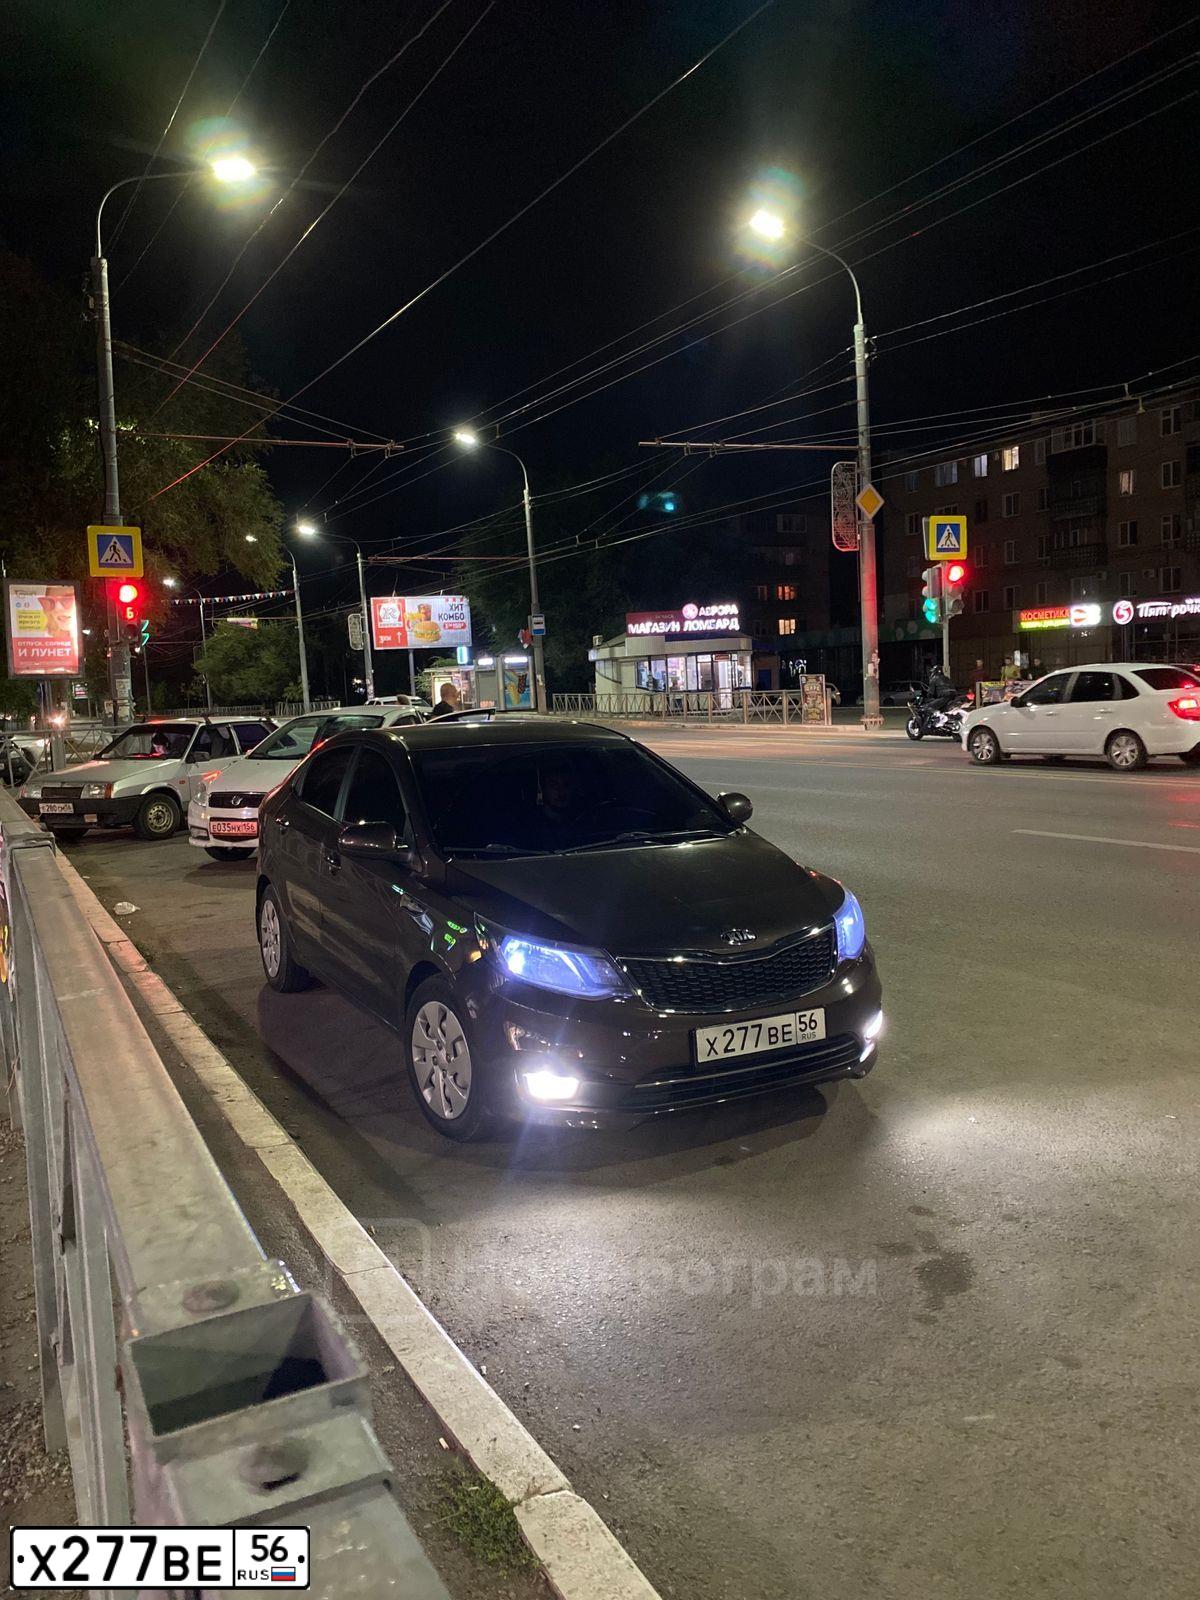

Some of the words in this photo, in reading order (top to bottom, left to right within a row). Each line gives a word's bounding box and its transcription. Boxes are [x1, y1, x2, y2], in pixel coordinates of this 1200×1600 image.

[438, 613, 465, 621] КОМБО
[628, 621, 680, 634] МАГАЗИН
[683, 618, 740, 631] ЛОМБАРД
[31, 648, 71, 657] ЛУНЕТ
[706, 1023, 792, 1057] Х277ВЕ
[799, 1013, 818, 1032] 56
[802, 1031, 816, 1040] RUS
